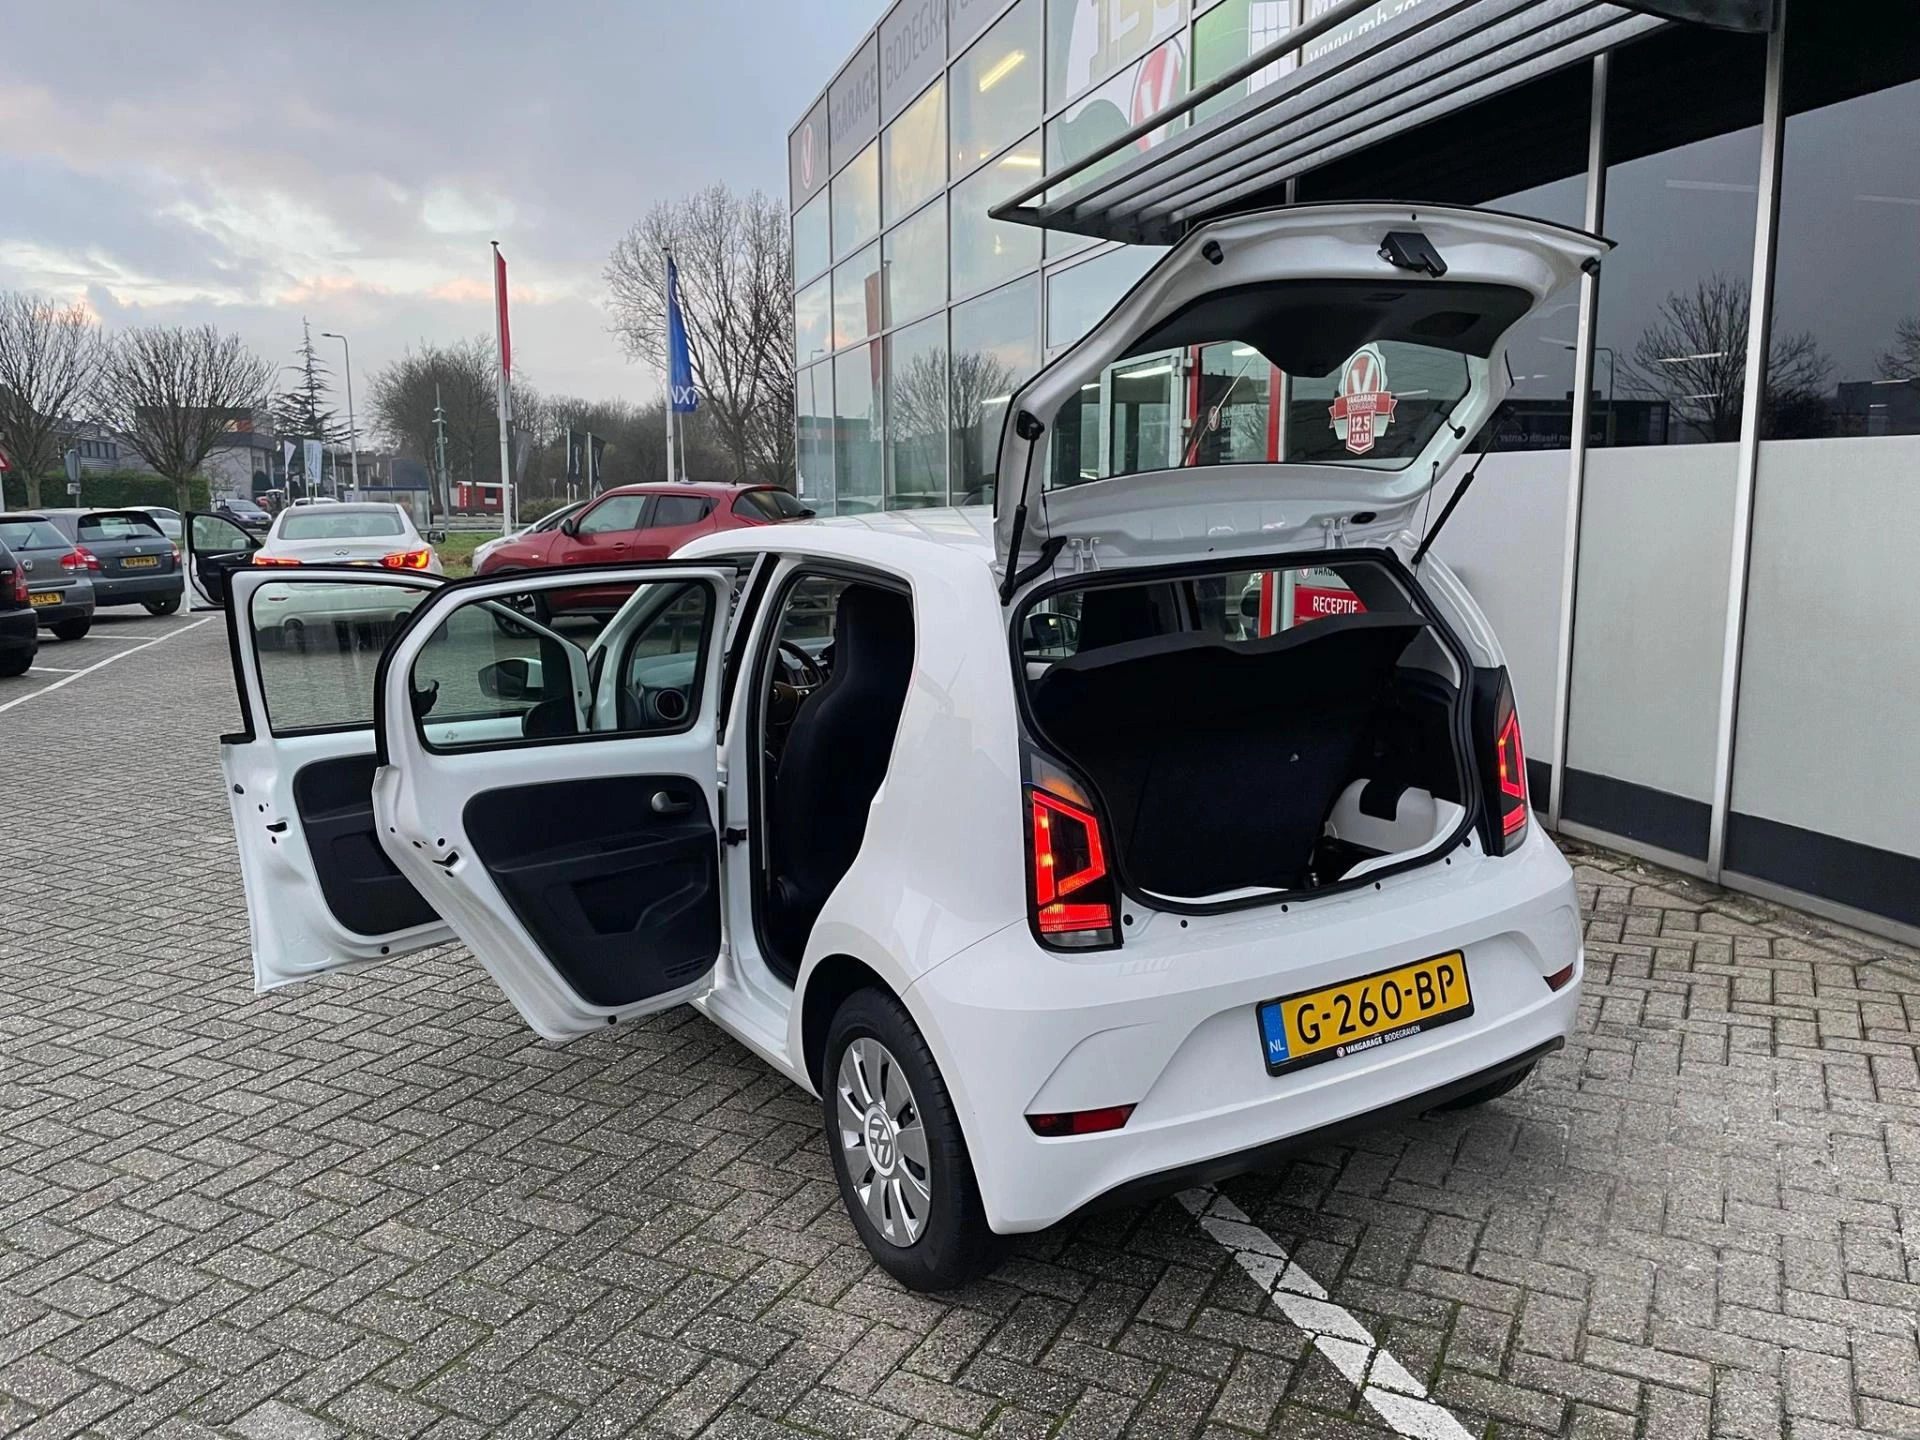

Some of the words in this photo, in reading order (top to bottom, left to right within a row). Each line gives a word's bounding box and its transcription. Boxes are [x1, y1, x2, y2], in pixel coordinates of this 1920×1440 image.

[1351, 432, 1370, 443] JAAR
[1296, 965, 1454, 1044] G-260-BP
[1269, 1039, 1286, 1053] NL
[1345, 1036, 1383, 1054] VAKGARAGE
[1384, 1025, 1421, 1043] BODEGRAVEN
